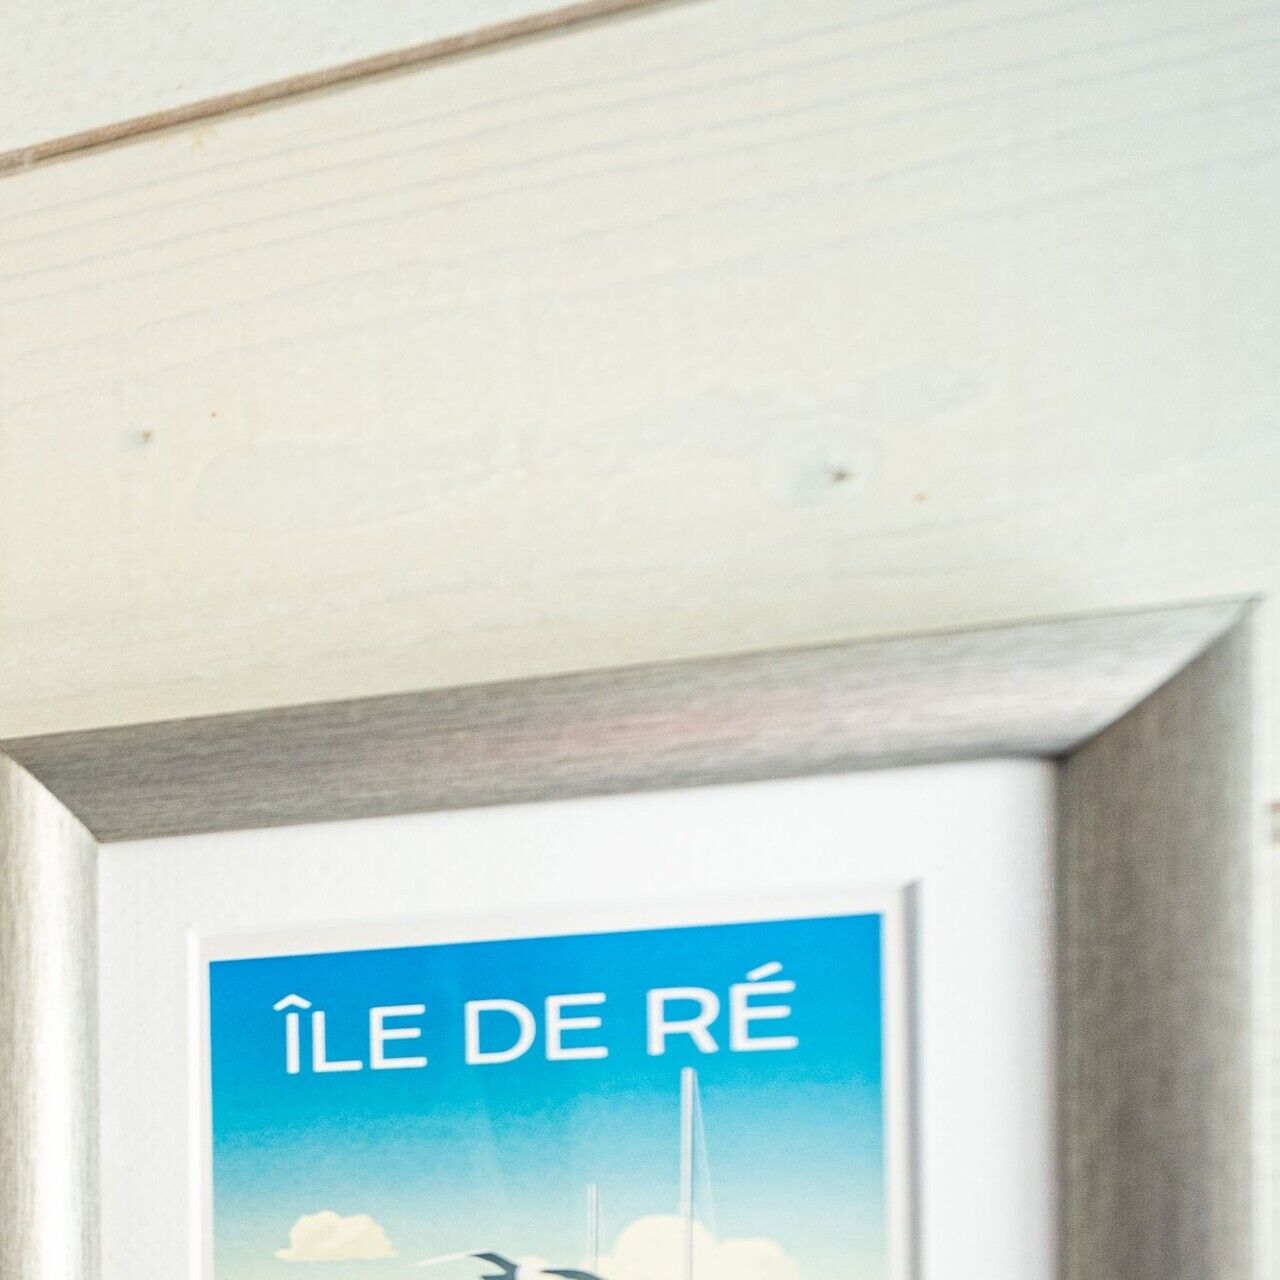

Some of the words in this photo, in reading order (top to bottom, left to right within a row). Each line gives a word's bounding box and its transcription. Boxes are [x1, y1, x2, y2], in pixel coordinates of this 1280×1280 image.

[273, 993, 428, 1074] ÎLE
[464, 992, 609, 1065] DE
[646, 961, 800, 1056] RÉ
